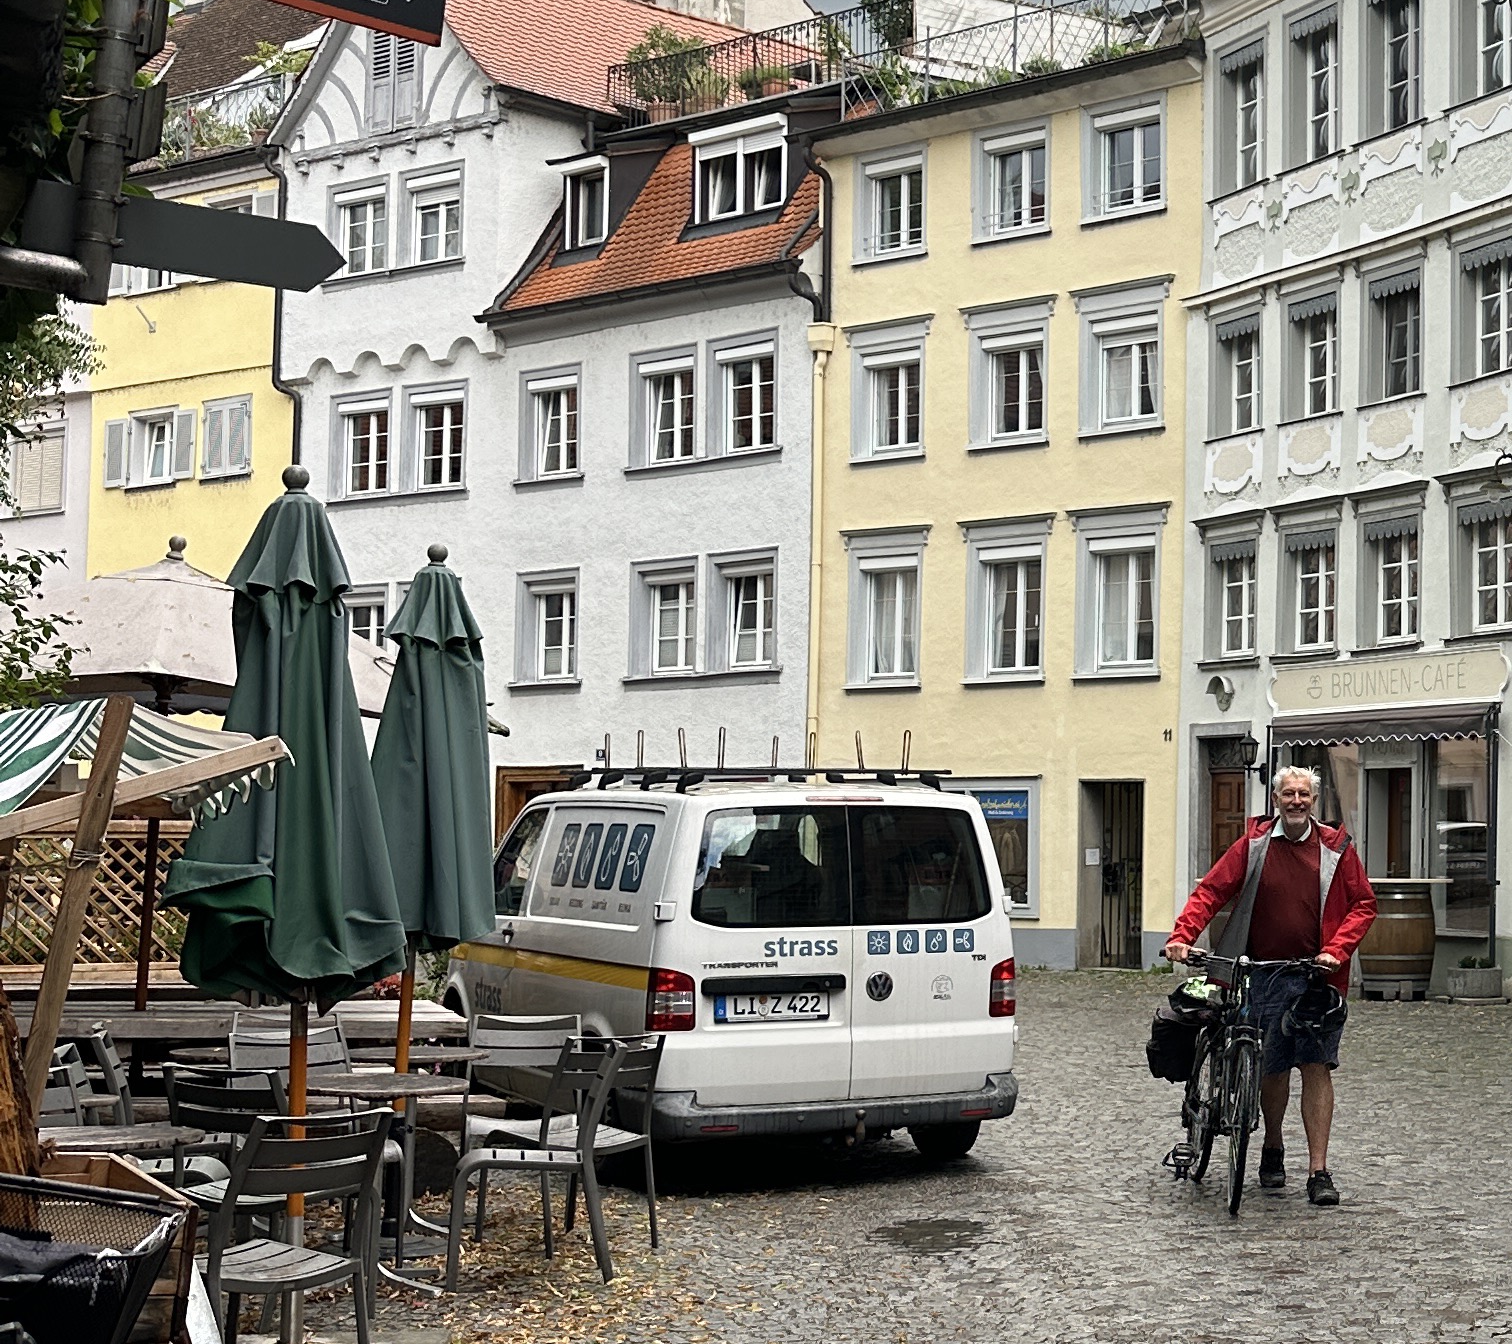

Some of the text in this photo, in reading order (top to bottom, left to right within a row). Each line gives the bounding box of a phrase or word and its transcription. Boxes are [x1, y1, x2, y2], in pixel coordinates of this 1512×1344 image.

[1331, 657, 1467, 699] BRUNNEN-CAFÉ
[1162, 728, 1172, 742] 11
[764, 936, 838, 958] strass
[701, 961, 778, 969] TRANSPORTER
[474, 976, 502, 1014] strass
[733, 997, 757, 1015] LI
[771, 996, 782, 1014] Z
[787, 995, 821, 1013] 422
